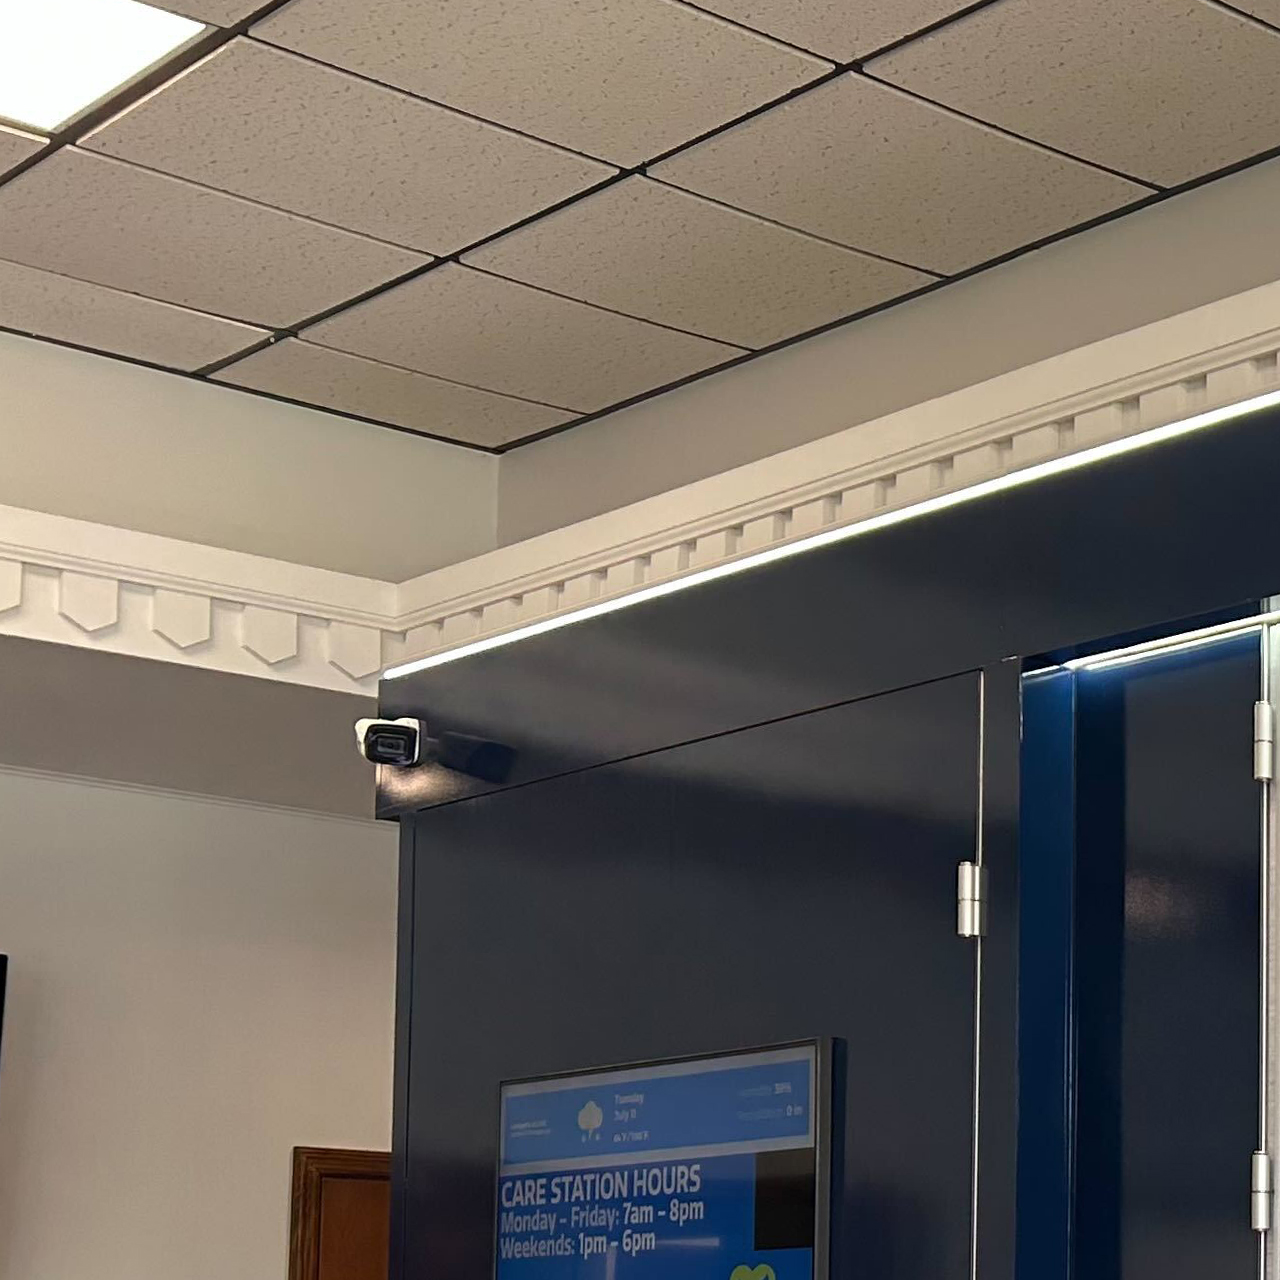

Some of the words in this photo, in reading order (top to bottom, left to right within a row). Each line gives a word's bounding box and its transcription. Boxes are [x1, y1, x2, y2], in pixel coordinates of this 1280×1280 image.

[502, 1178, 547, 1207] CARE
[551, 1171, 629, 1203] STATION
[633, 1164, 701, 1197] HOURS
[501, 1210, 556, 1233] Monday
[571, 1206, 619, 1231] Friday:
[623, 1202, 653, 1224] 7am
[669, 1199, 704, 1226] 8pm
[501, 1233, 575, 1259] Weekends:
[578, 1232, 606, 1260] 1pm
[622, 1229, 655, 1256] 6pm
